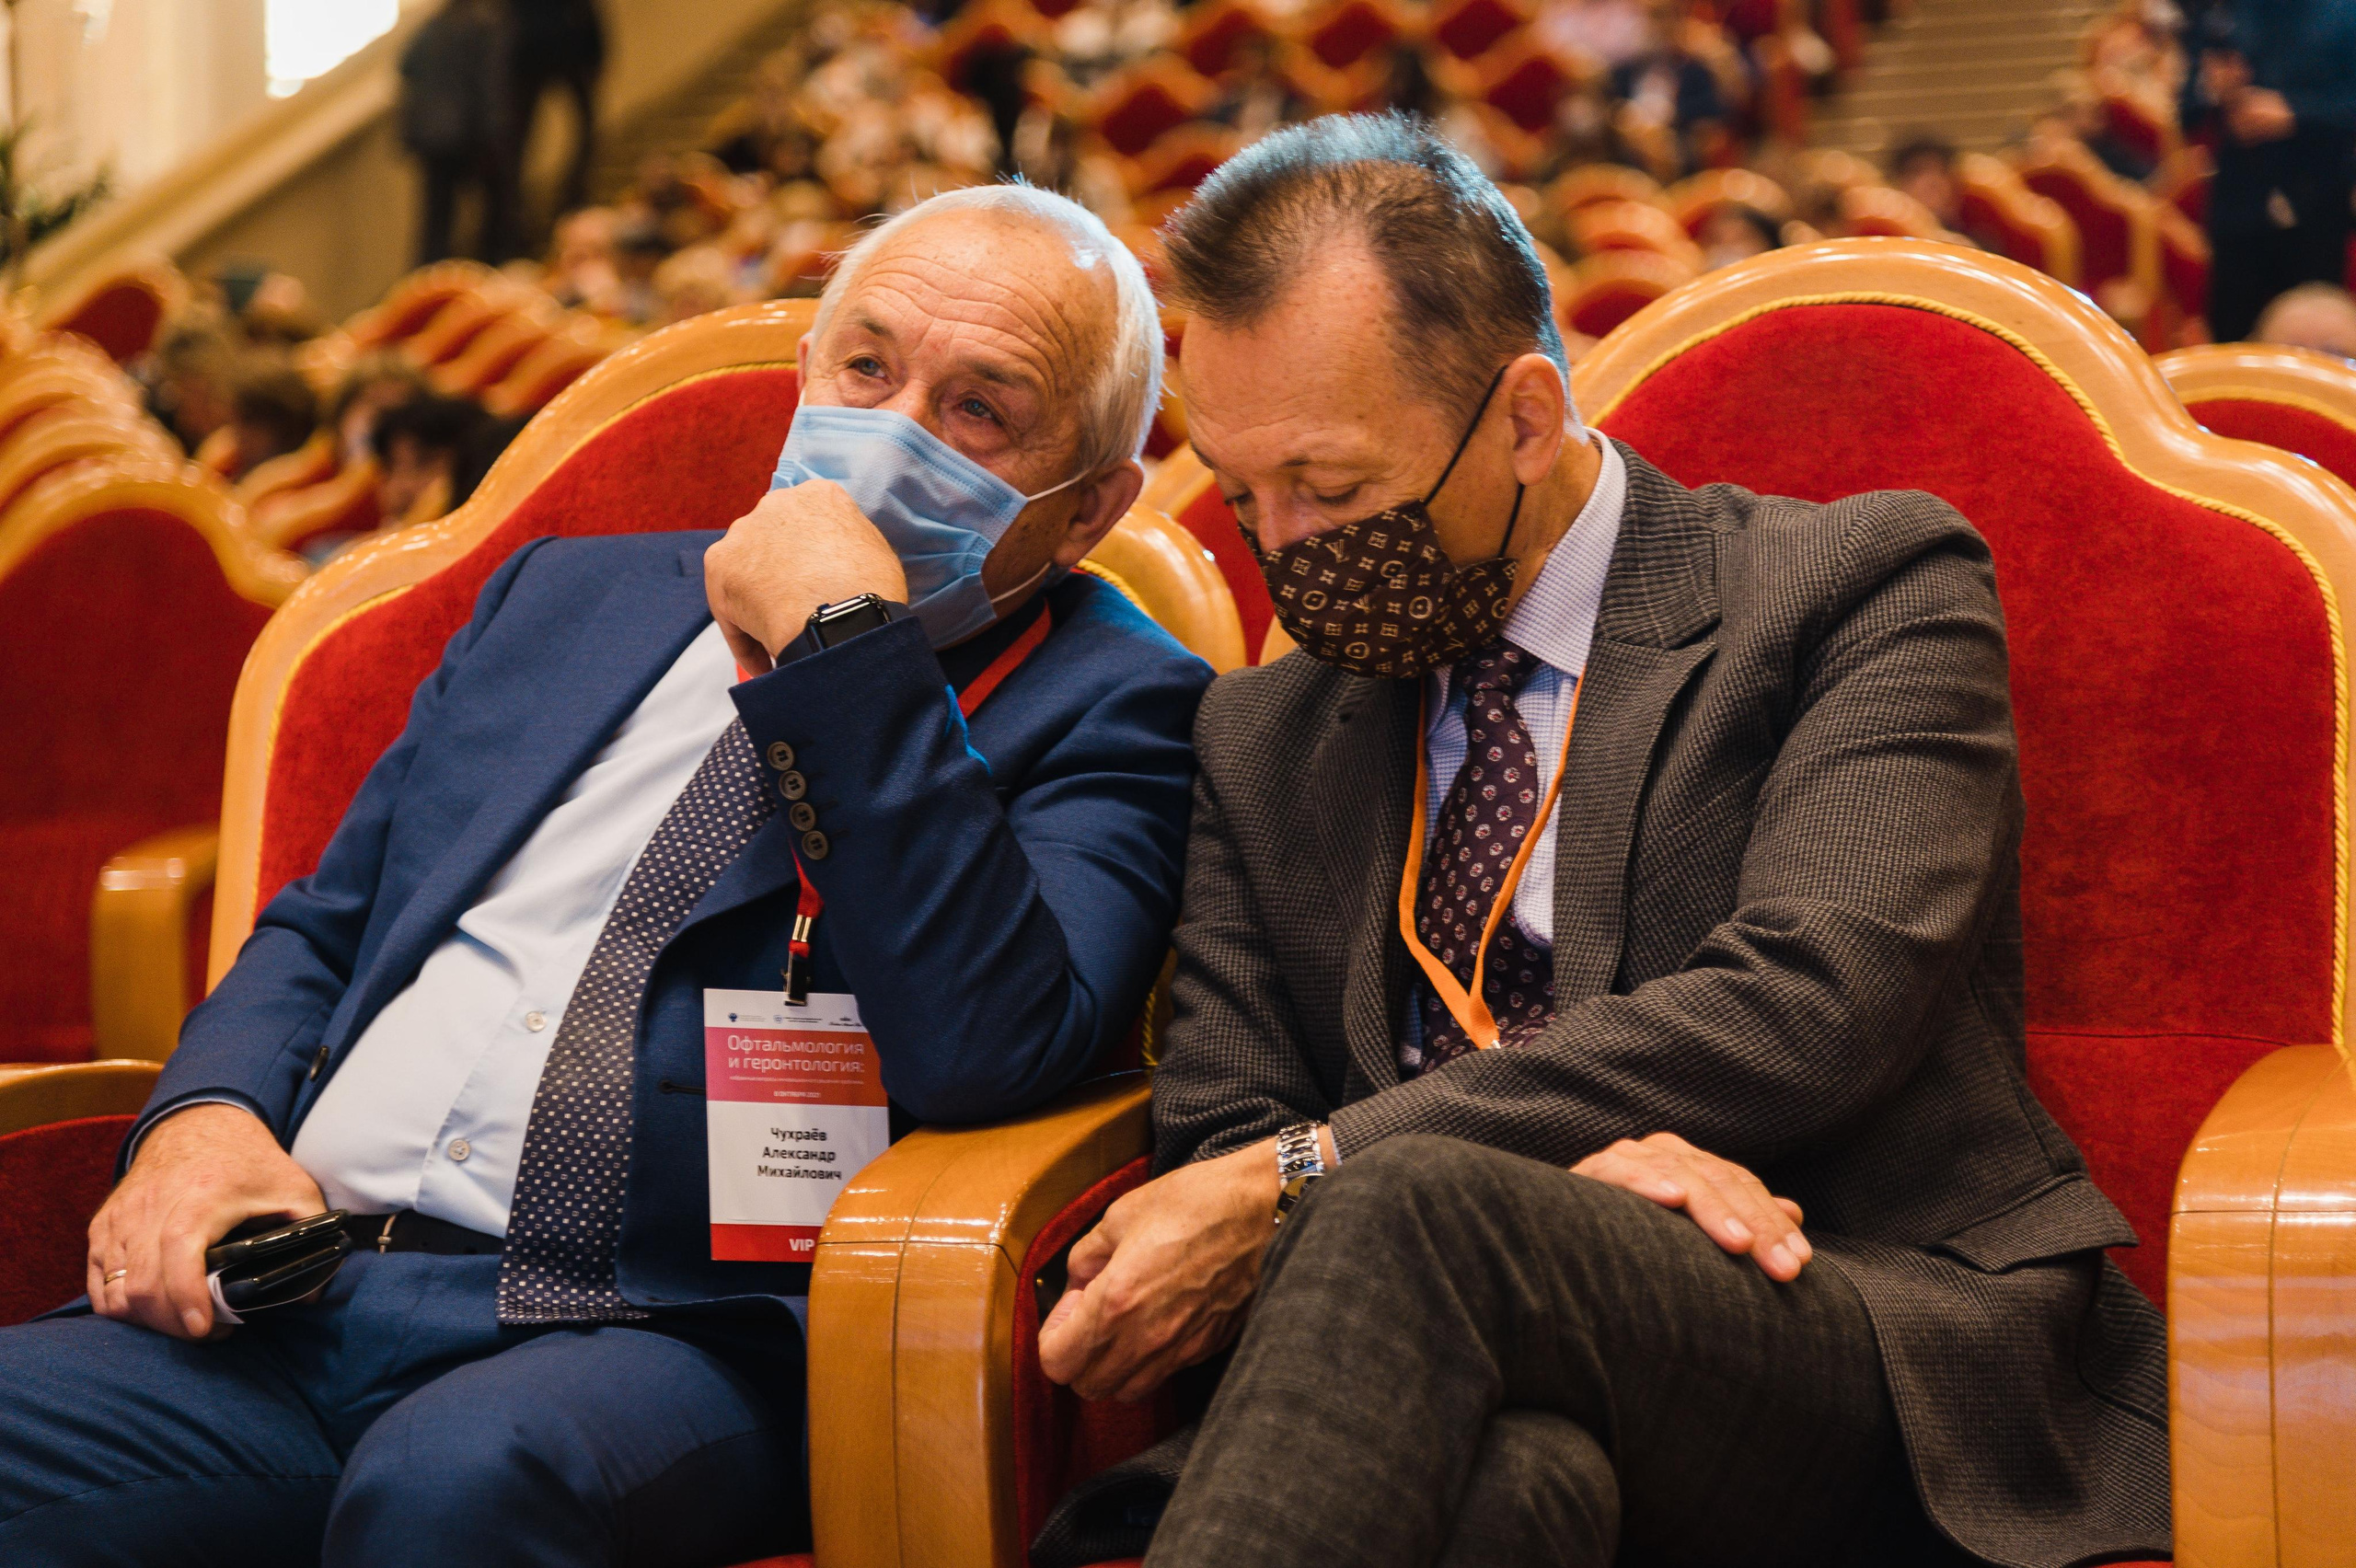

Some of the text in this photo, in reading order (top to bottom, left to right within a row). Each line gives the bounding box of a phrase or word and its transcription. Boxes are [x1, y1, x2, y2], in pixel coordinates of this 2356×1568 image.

[727, 1034, 865, 1055] Офтальмология
[728, 1056, 866, 1073] и геронтология:
[770, 1127, 827, 1142] Чухраёв
[762, 1147, 837, 1163] Александр
[756, 1165, 842, 1180] Михайлович
[789, 1239, 815, 1251] VIP
